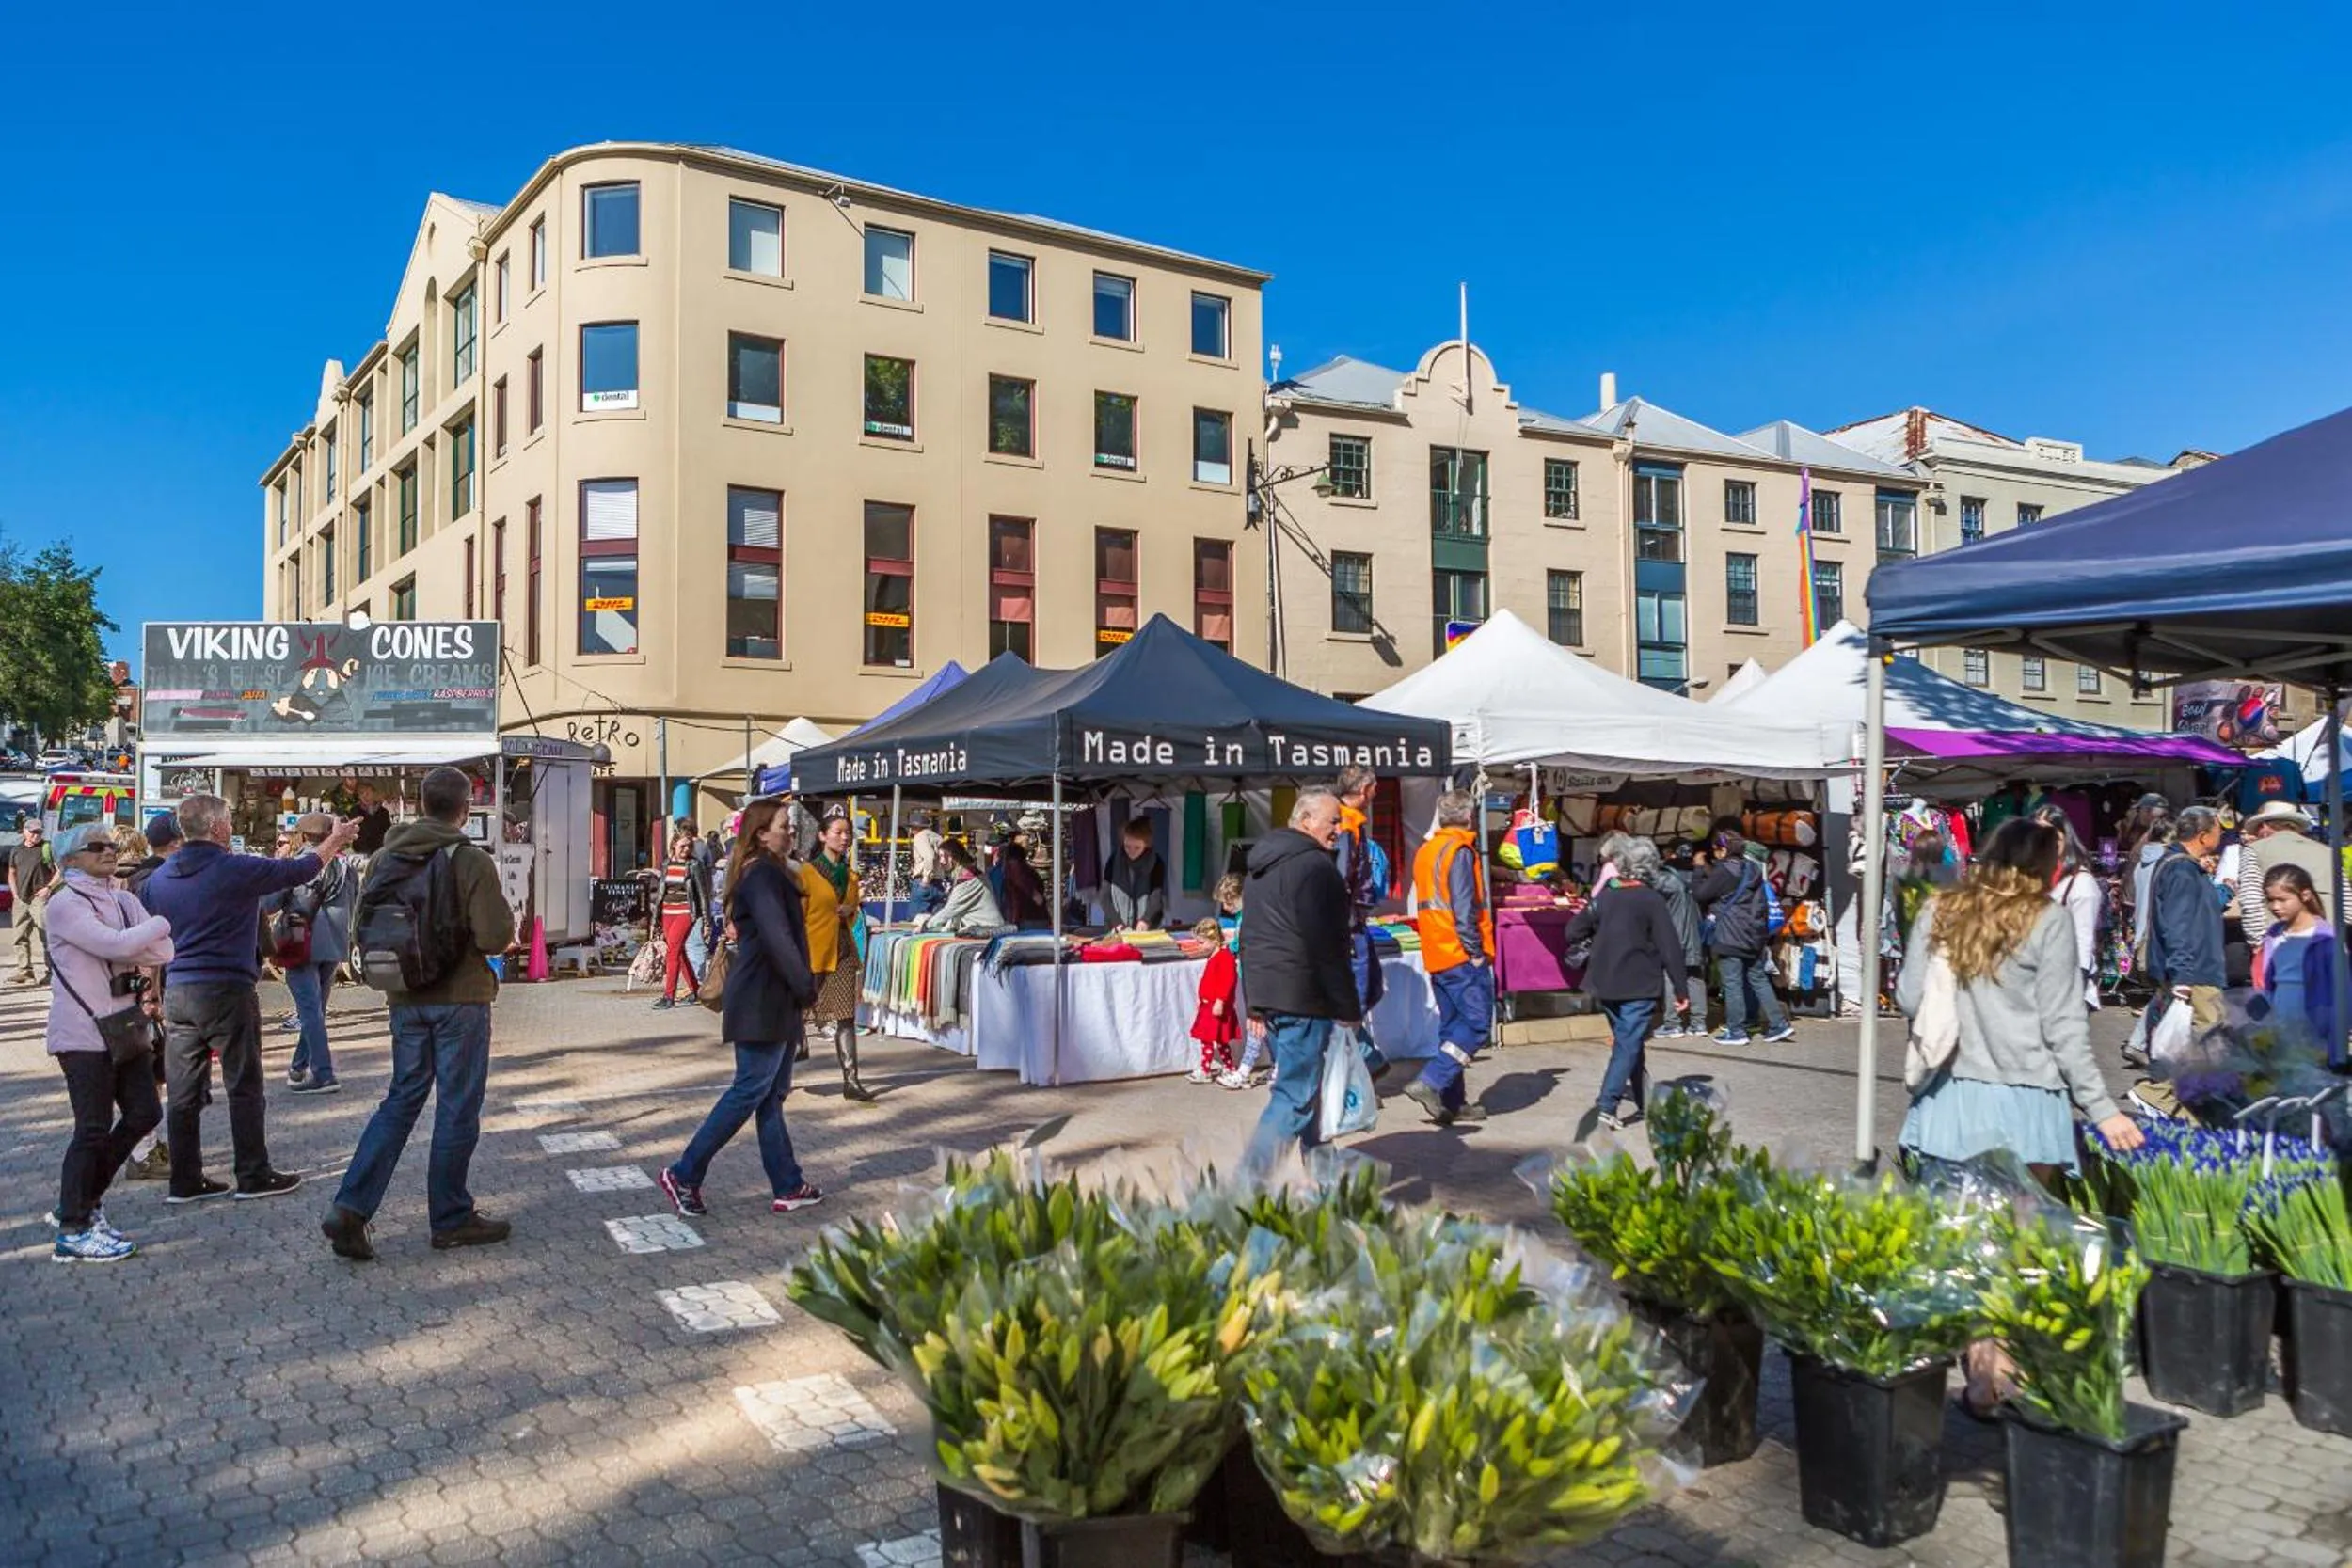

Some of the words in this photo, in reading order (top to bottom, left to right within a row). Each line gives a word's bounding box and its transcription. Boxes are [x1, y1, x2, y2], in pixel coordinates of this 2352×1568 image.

[167, 626, 290, 660] VIKING
[371, 625, 474, 660] CONES
[408, 663, 493, 687] CREAMS
[837, 755, 866, 783] Made
[873, 752, 889, 779] in
[897, 741, 966, 777] Tasmania
[1084, 730, 1174, 765] Made
[1204, 736, 1243, 766] in
[1268, 735, 1432, 767] Tasmania
[592, 767, 615, 777] AFE
